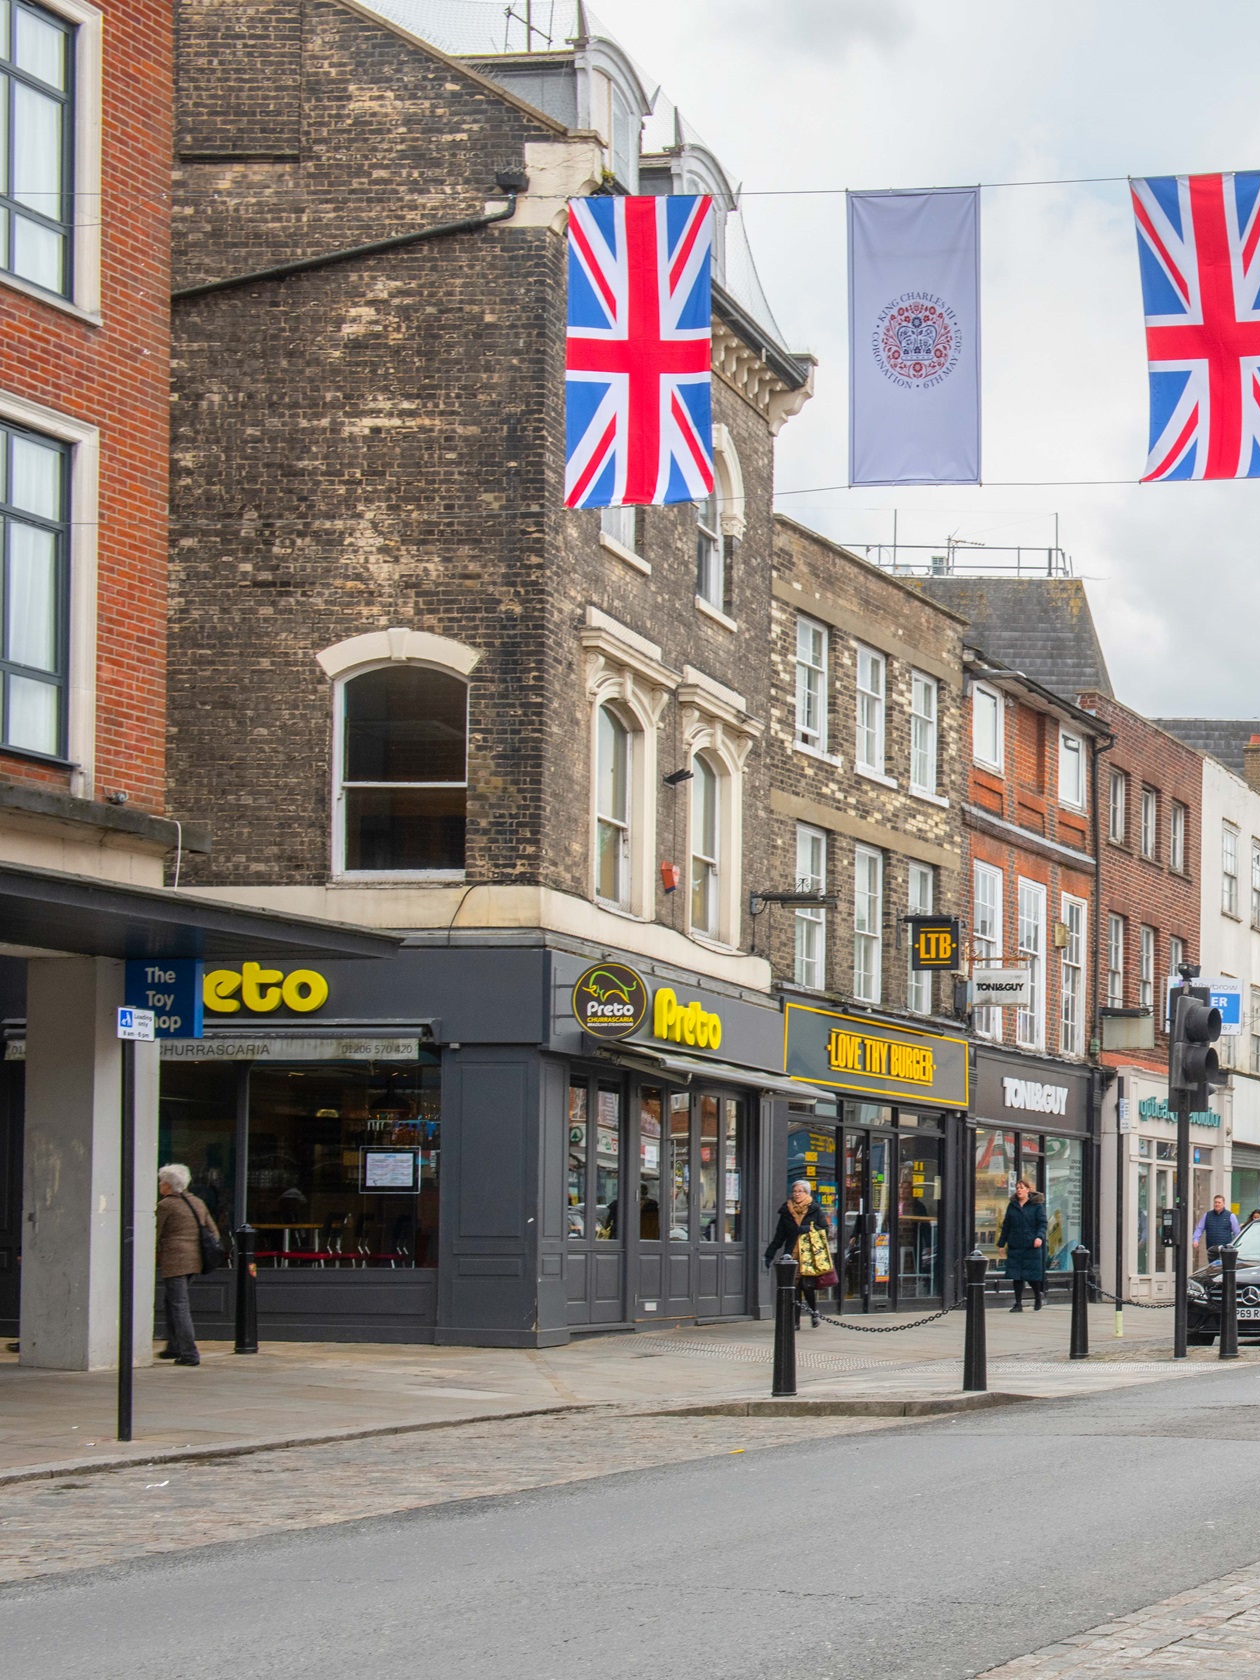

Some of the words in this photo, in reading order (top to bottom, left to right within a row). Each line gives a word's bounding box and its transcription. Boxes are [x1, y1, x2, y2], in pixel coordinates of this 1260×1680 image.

[877, 298, 899, 322] KING
[900, 292, 946, 309] CHARLES
[945, 306, 956, 320] III
[872, 331, 913, 389] CORONATION
[923, 374, 944, 389] 6TH
[942, 355, 958, 377] MAY
[919, 933, 952, 959] LTB
[144, 966, 176, 984] The
[202, 961, 329, 1013] eto
[976, 982, 1025, 992] TONI&GUY
[145, 990, 175, 1011] Toy
[587, 1001, 634, 1016] Preto
[134, 1013, 152, 1022] Loading
[653, 987, 722, 1051] Preto
[341, 1044, 372, 1055] 01206
[374, 1044, 392, 1055] 570
[394, 1044, 413, 1055] 420
[830, 1032, 862, 1071] LOVE
[863, 1038, 889, 1074] THY
[890, 1043, 933, 1082] BURGER
[1002, 1076, 1069, 1116] TONI&GUY
[1236, 1309, 1252, 1318] P69
